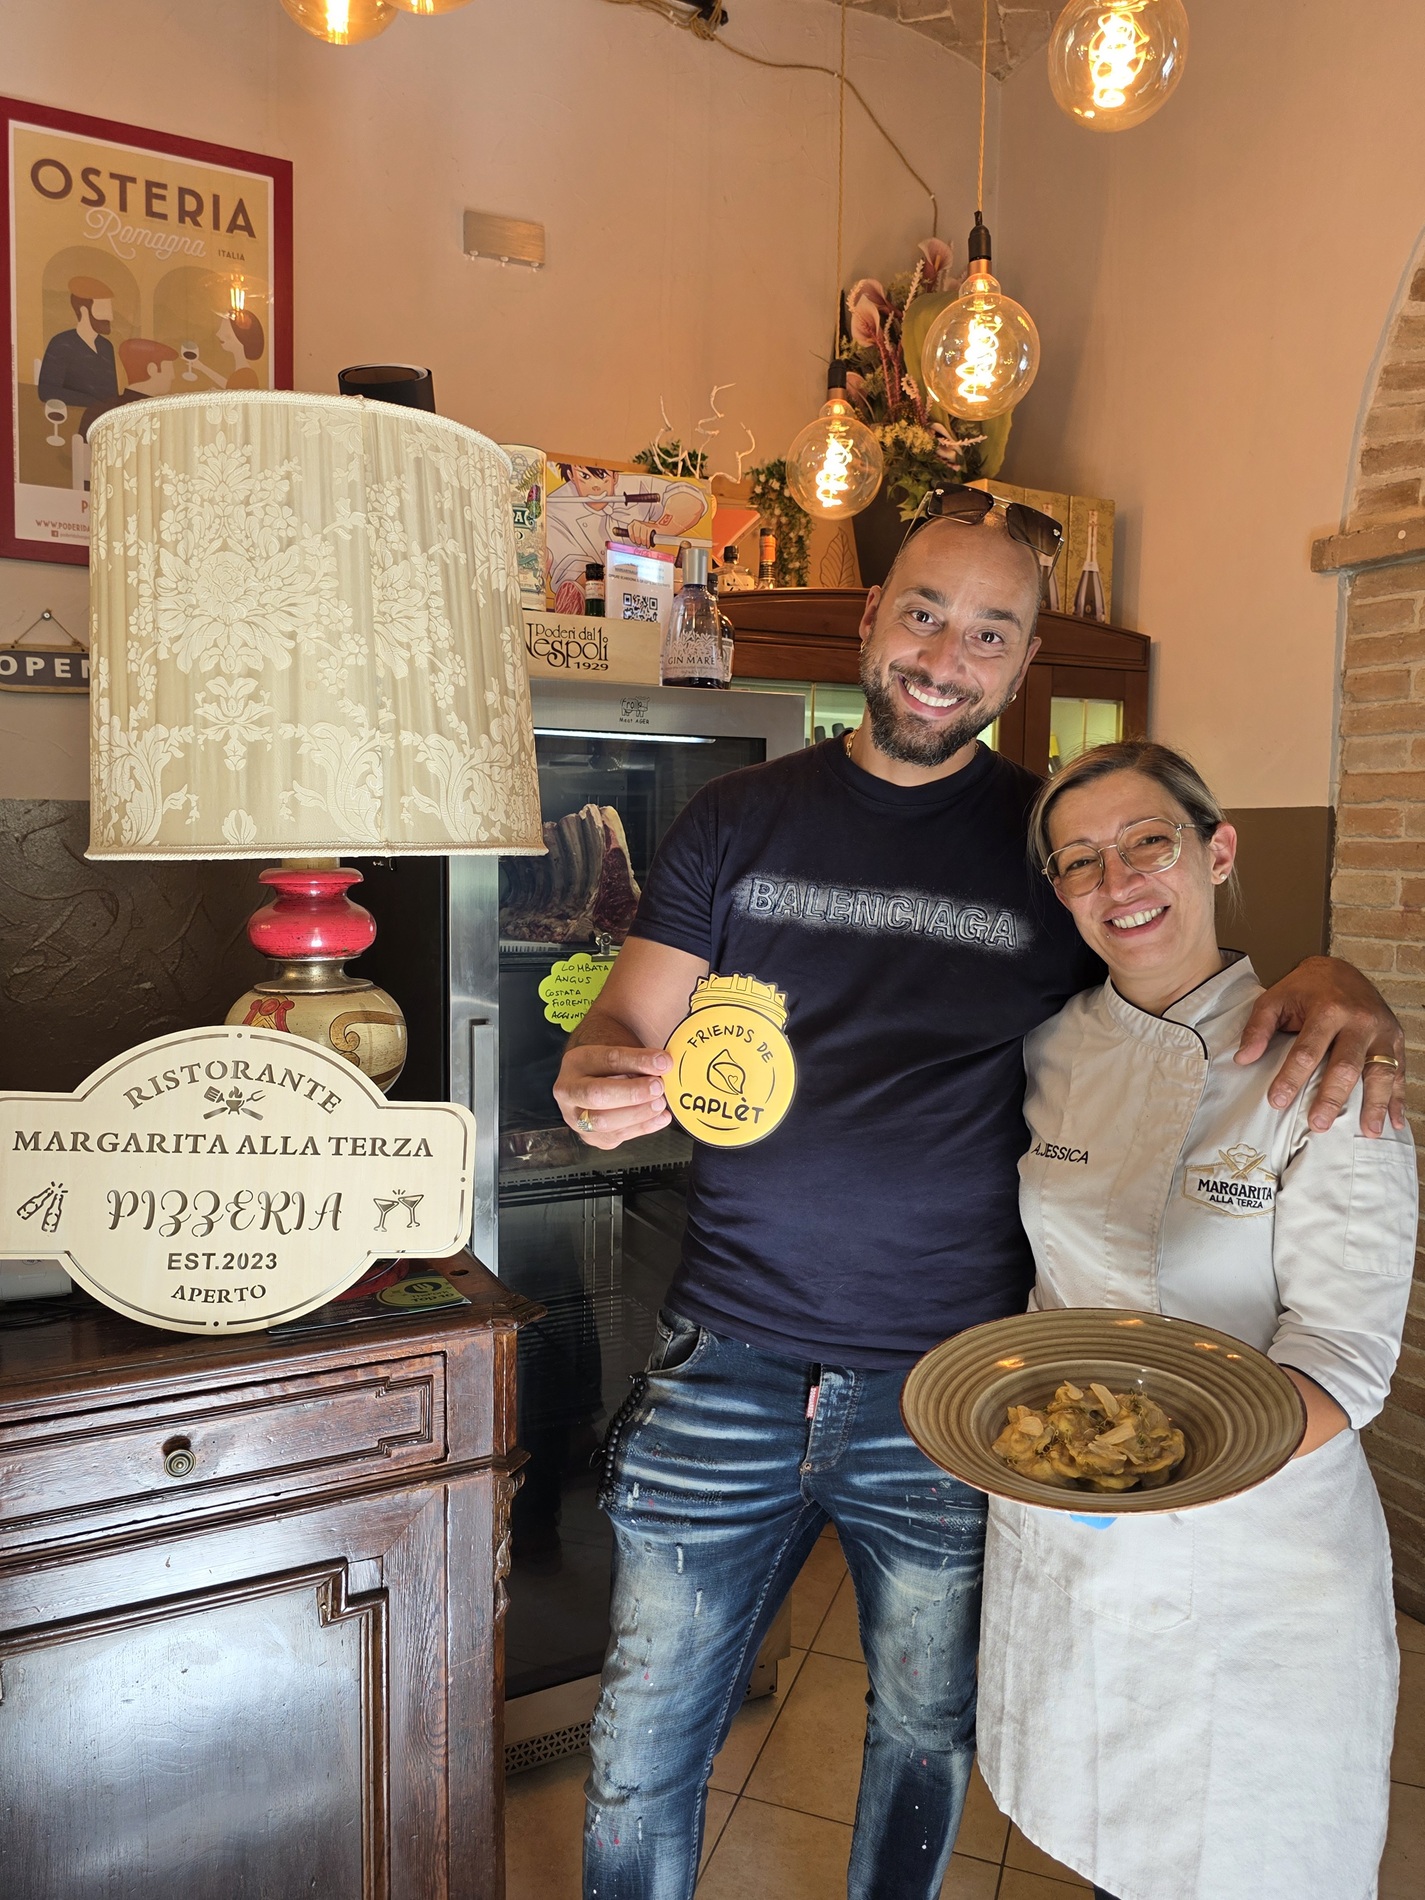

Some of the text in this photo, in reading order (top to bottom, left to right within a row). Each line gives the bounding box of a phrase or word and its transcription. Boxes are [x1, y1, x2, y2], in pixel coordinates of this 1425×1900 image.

[30, 158, 257, 240] OSTERIA
[83, 206, 207, 260] Romagna
[217, 249, 246, 262] ITALIA
[535, 623, 596, 641] Poderi dal
[525, 622, 609, 668] Nespoli
[573, 661, 609, 671] 1929
[667, 656, 716, 666] GIN MARE
[749, 876, 1018, 950] BALENCIAGA
[561, 963, 610, 973] LOMBATA
[554, 974, 592, 985] ANGUS
[687, 1024, 774, 1064] FRIENDS DE
[122, 1060, 343, 1115] RISTORANTE
[12, 1130, 434, 1158] MARGARITA ALLA TERZA
[1197, 1178, 1273, 1201] MARGARITA
[1209, 1194, 1264, 1209] ALLA TERZA
[106, 1188, 343, 1238] PIZZERIA
[167, 1252, 278, 1271] EST.2023
[171, 1284, 267, 1304] APERTO
